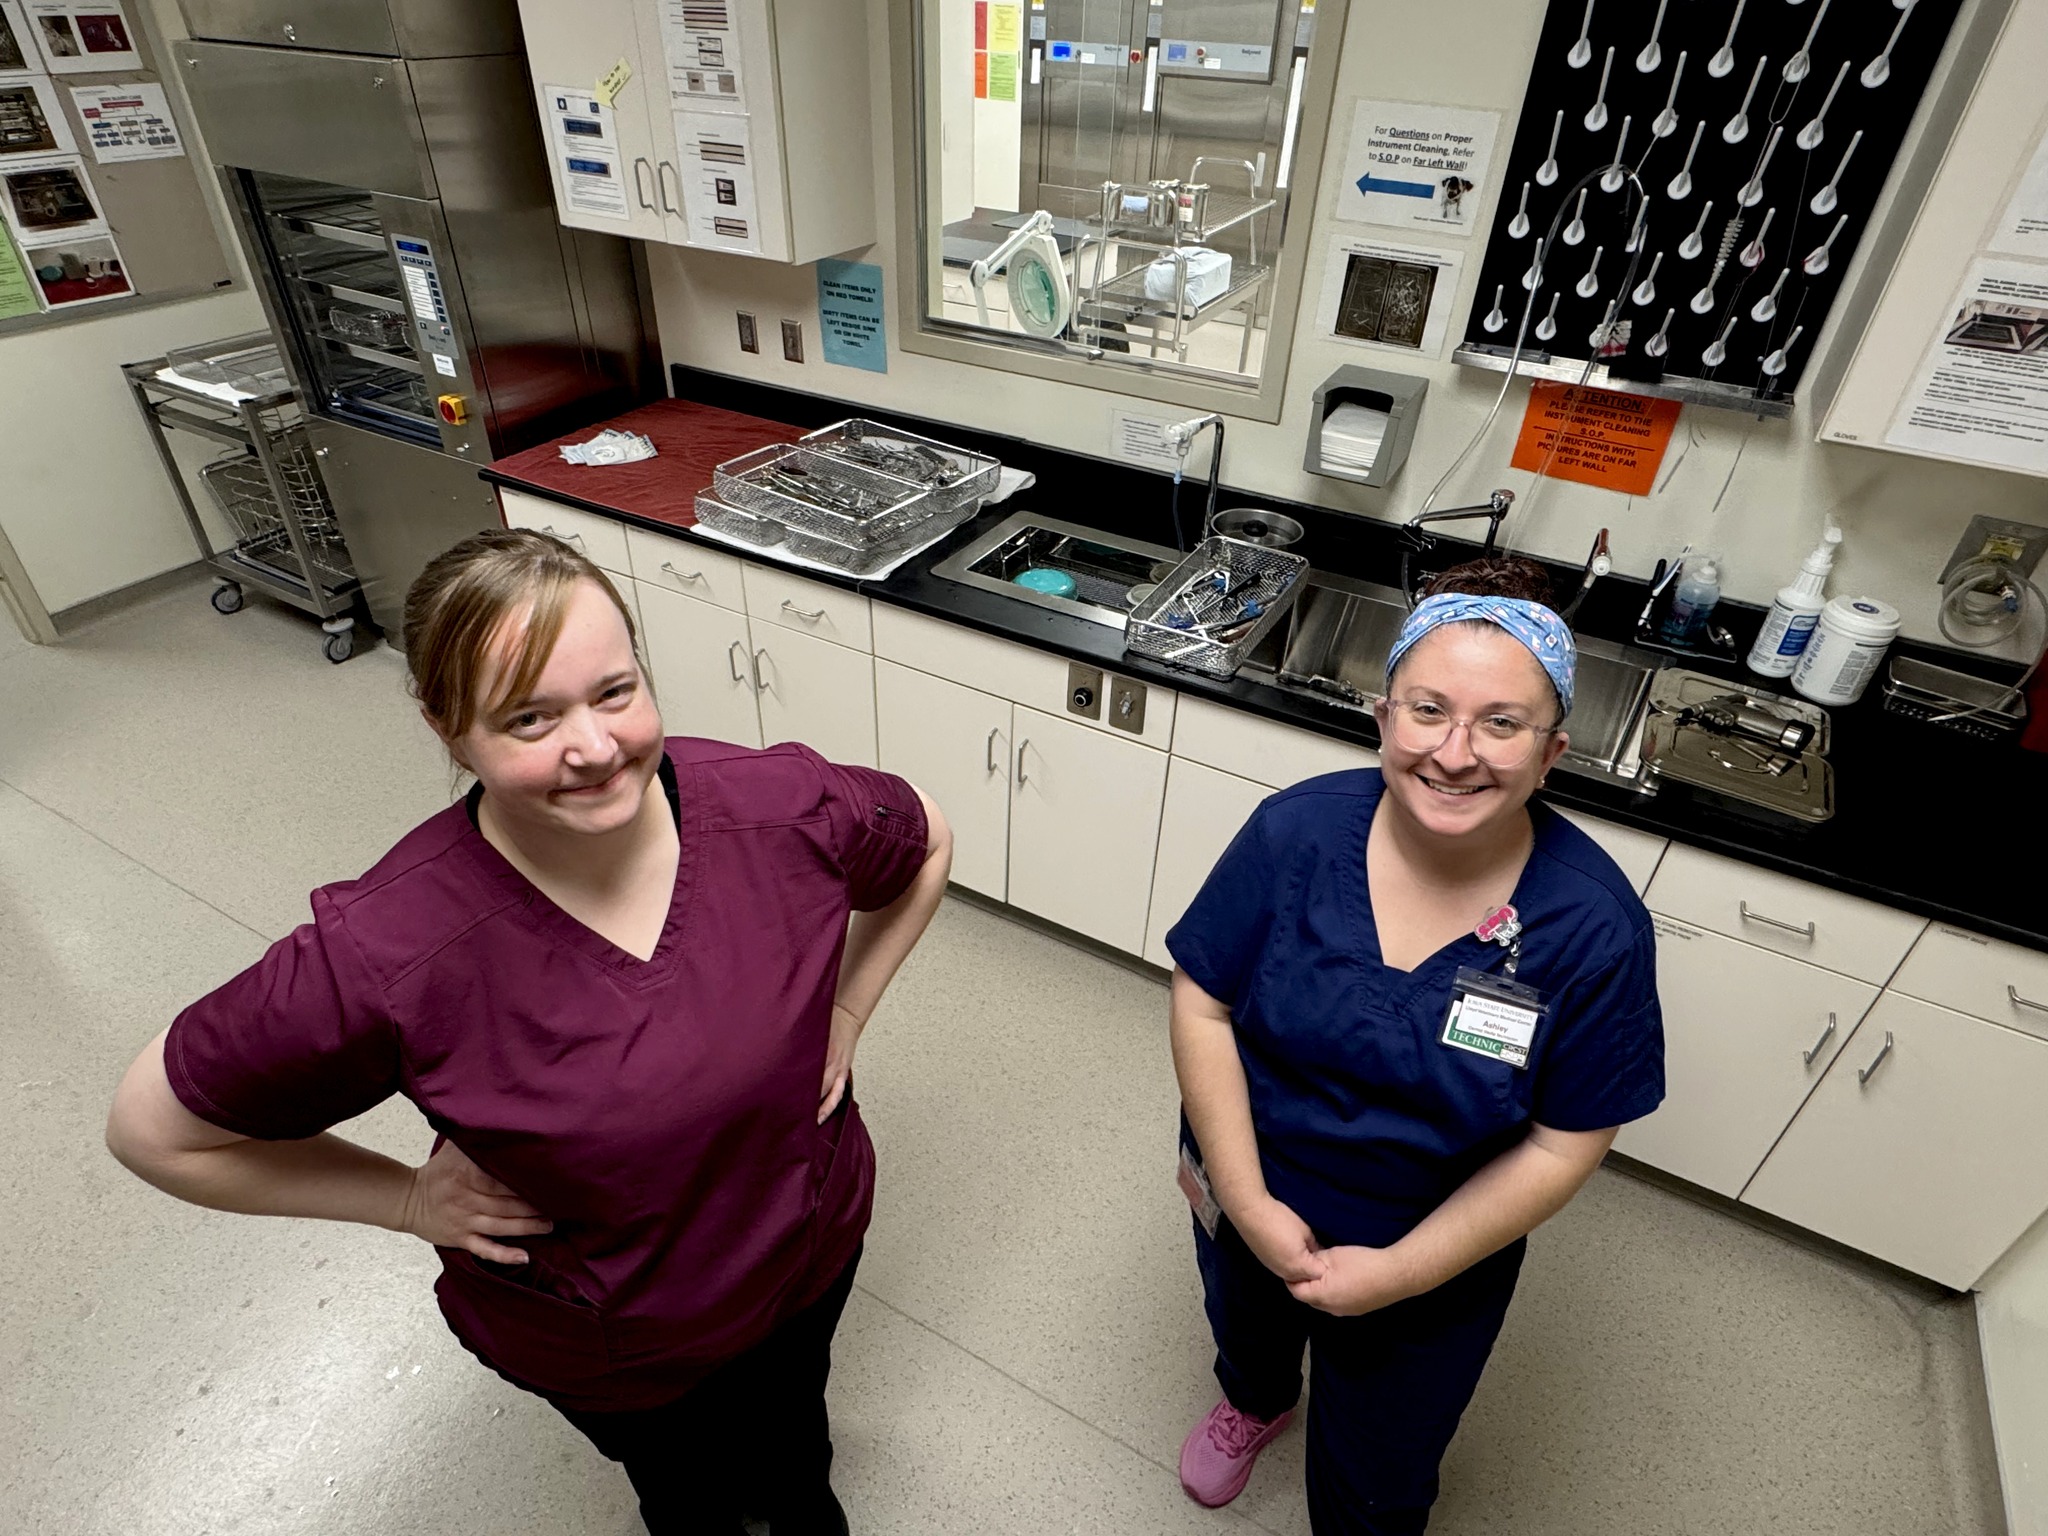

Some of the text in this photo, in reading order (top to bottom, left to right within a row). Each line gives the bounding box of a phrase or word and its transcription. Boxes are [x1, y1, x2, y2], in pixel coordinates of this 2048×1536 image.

[1375, 126, 1388, 134] For
[1388, 127, 1430, 140] Questions
[1444, 133, 1473, 144] Proper
[1368, 138, 1411, 151] Instrument
[1452, 147, 1475, 157] Refer
[1369, 152, 1377, 160] to
[1413, 157, 1426, 167] Far
[1428, 158, 1443, 169] Left
[1446, 160, 1468, 171] Wall!
[1563, 388, 1646, 412] ATENTION:
[1549, 400, 1653, 426] PLESE REFER TO THE
[1544, 410, 1651, 437] INSTUMENT CLEANING
[1580, 427, 1606, 439] S.O.P.
[1545, 432, 1636, 457] INTRUCTIONS WITH
[1537, 441, 1638, 468] PICURES ARE ON FAR
[1558, 456, 1608, 473] LEFT WALL
[1483, 1020, 1508, 1033] Ashley
